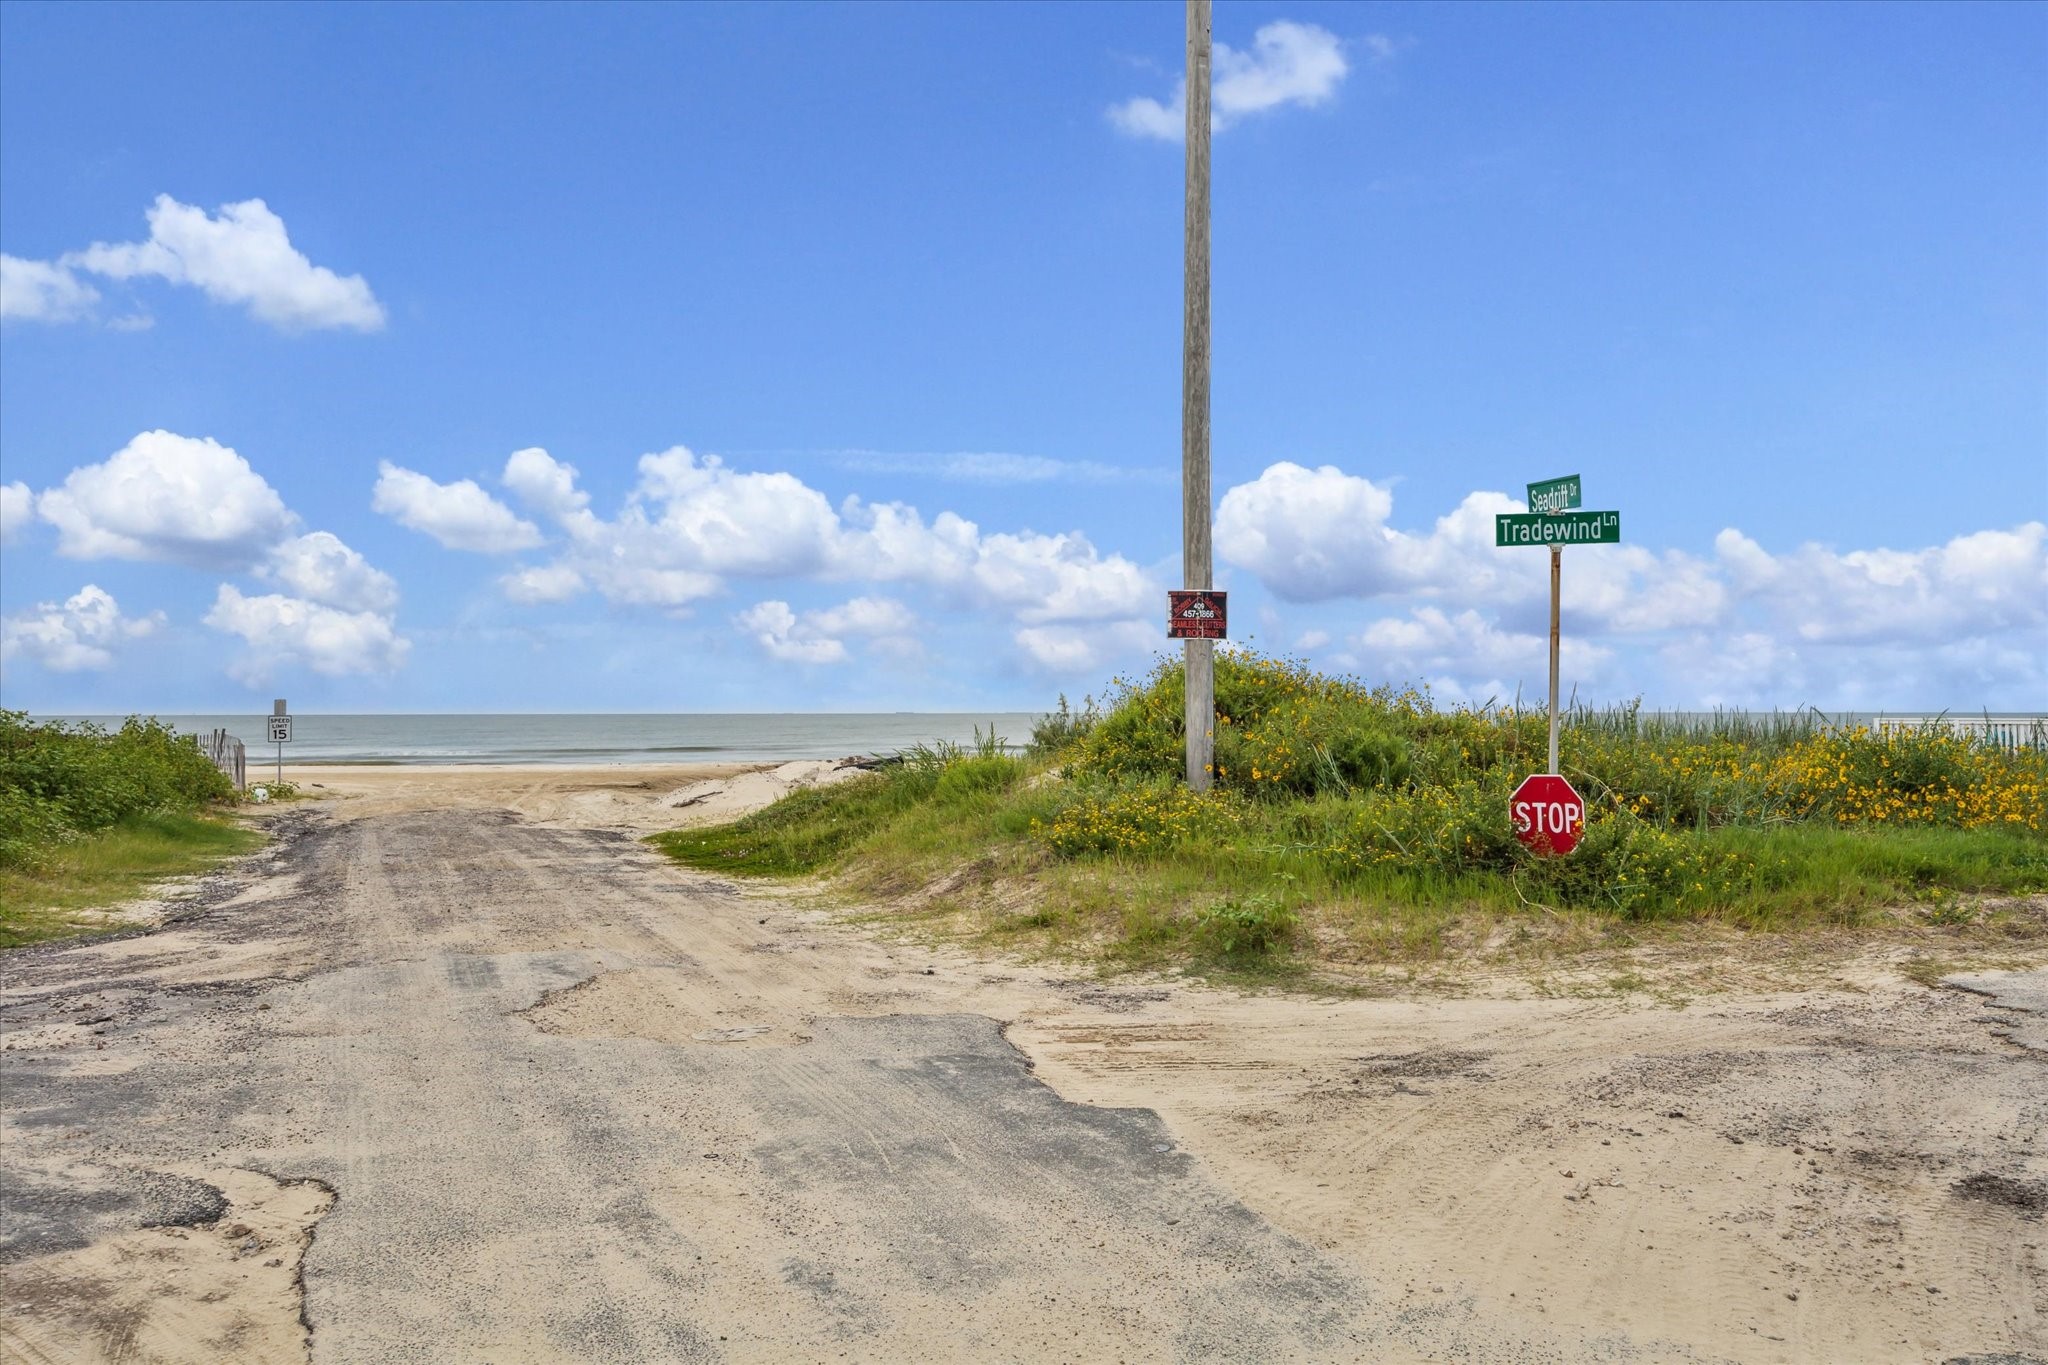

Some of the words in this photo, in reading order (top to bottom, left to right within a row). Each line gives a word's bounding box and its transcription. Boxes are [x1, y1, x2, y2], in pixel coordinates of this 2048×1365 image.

[1531, 485, 1568, 512] Seadrift
[1570, 483, 1577, 496] Dr
[1500, 516, 1601, 542] Tradewind
[1603, 513, 1617, 526] Ln
[1193, 602, 1205, 610] 409
[273, 729, 287, 740] 15
[1516, 802, 1579, 834] STOP
